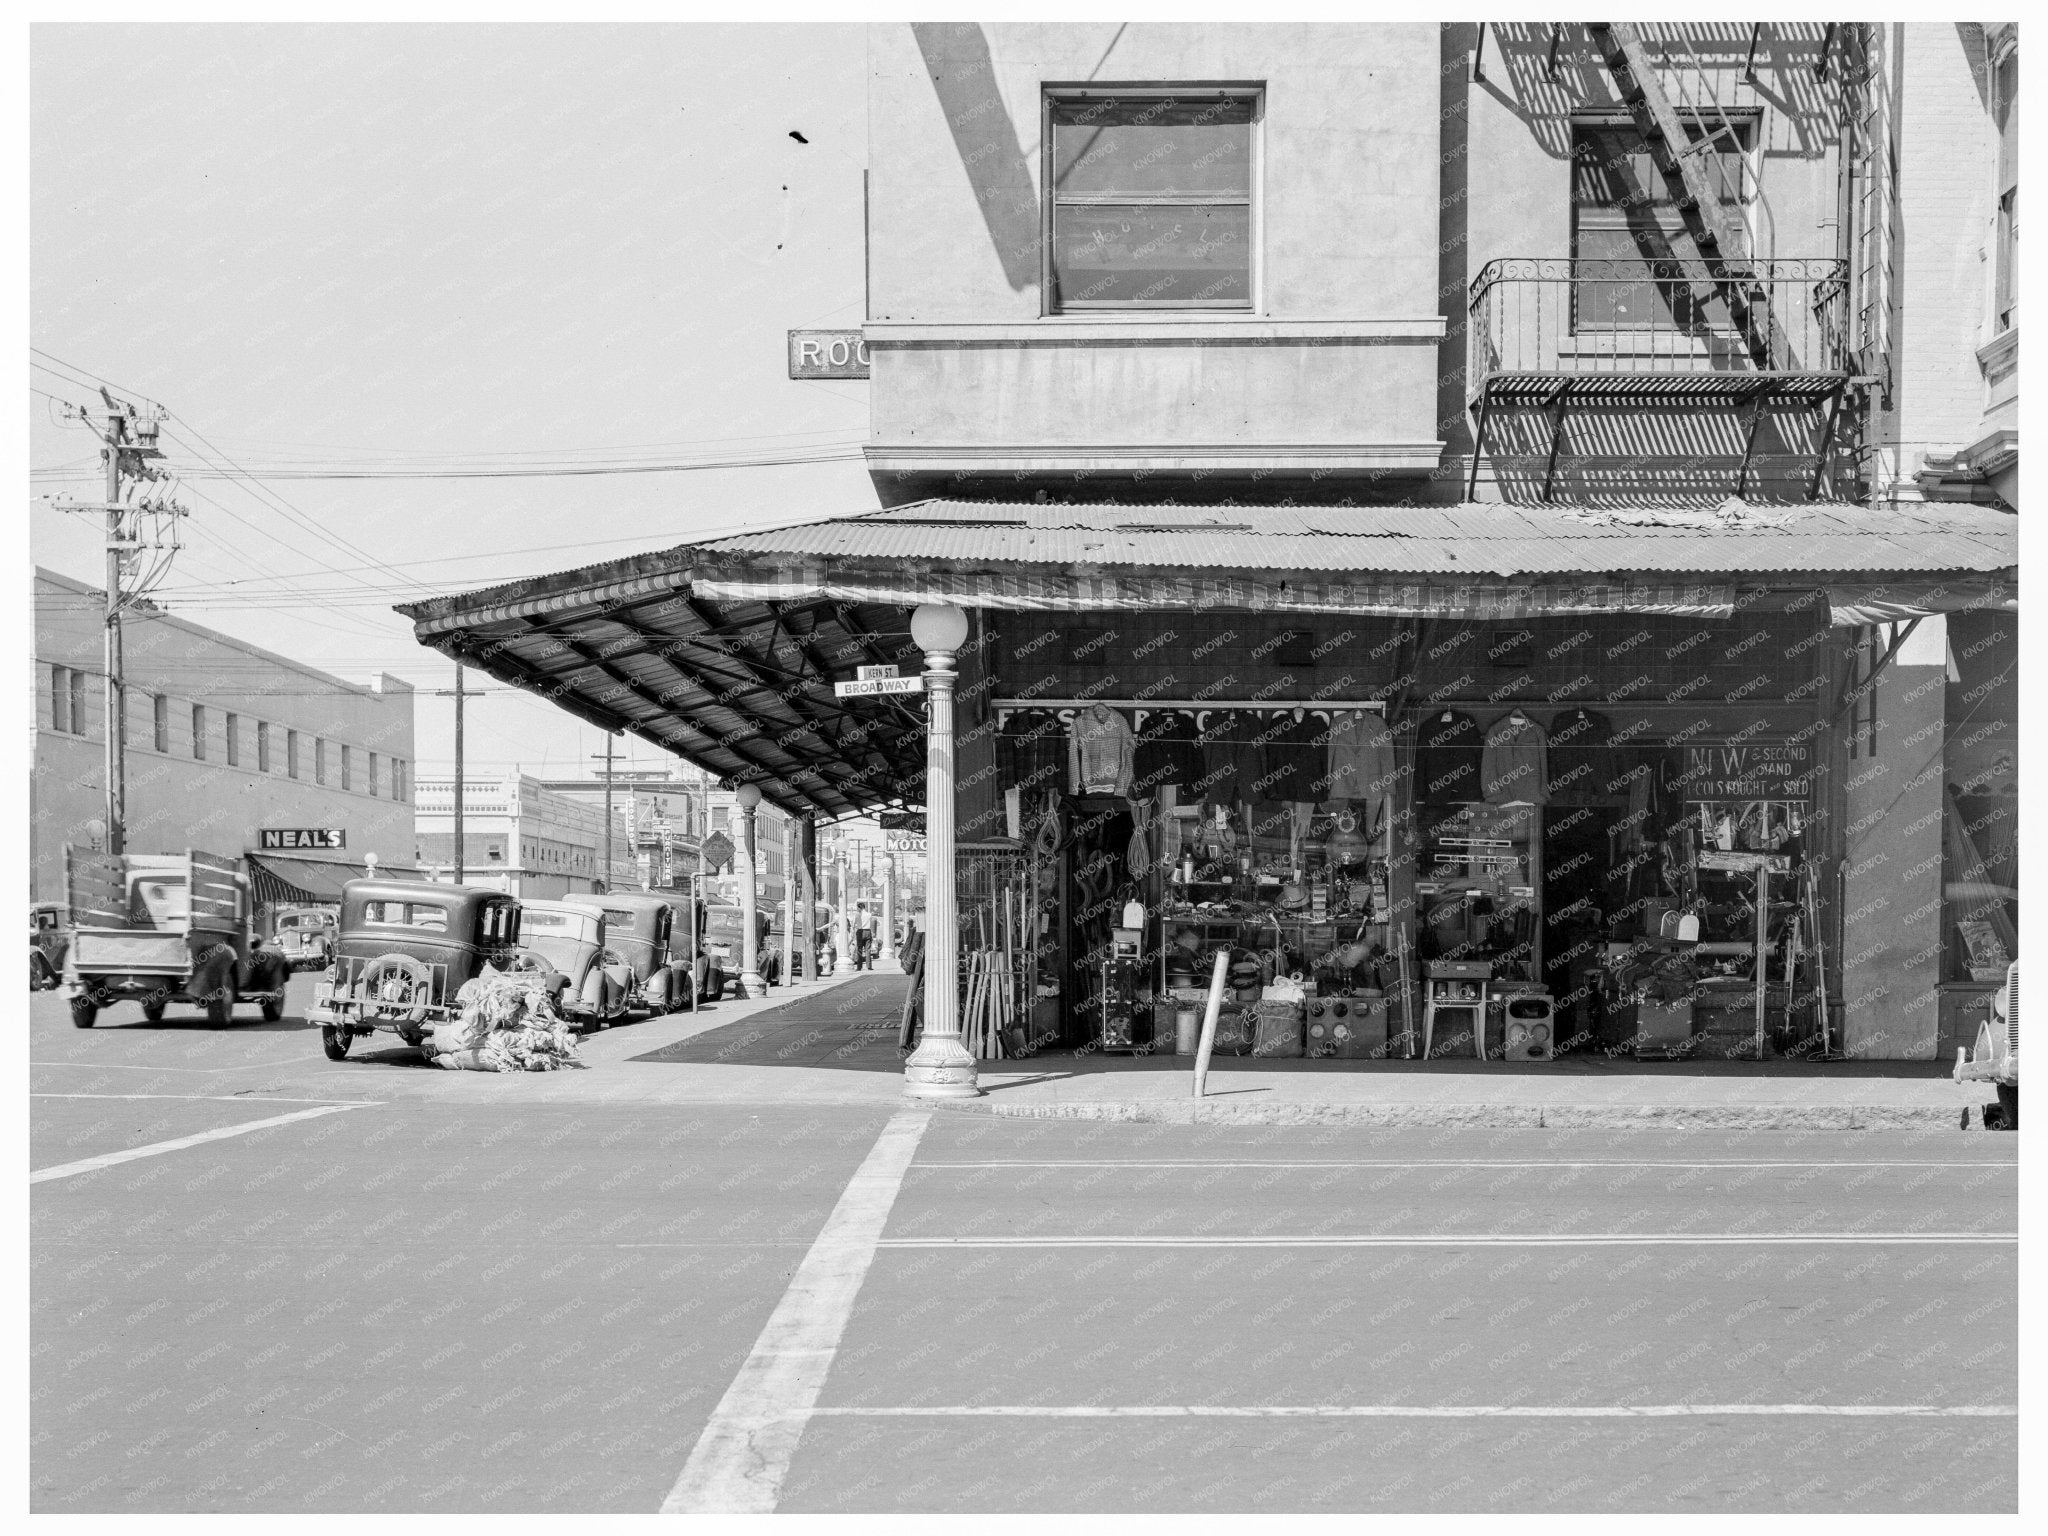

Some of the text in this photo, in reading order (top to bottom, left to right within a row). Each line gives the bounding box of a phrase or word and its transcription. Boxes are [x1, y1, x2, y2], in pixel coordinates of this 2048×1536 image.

[844, 680, 911, 694] BROADWAY
[1763, 747, 1807, 761] SECOND
[266, 829, 341, 847] NEAL'S
